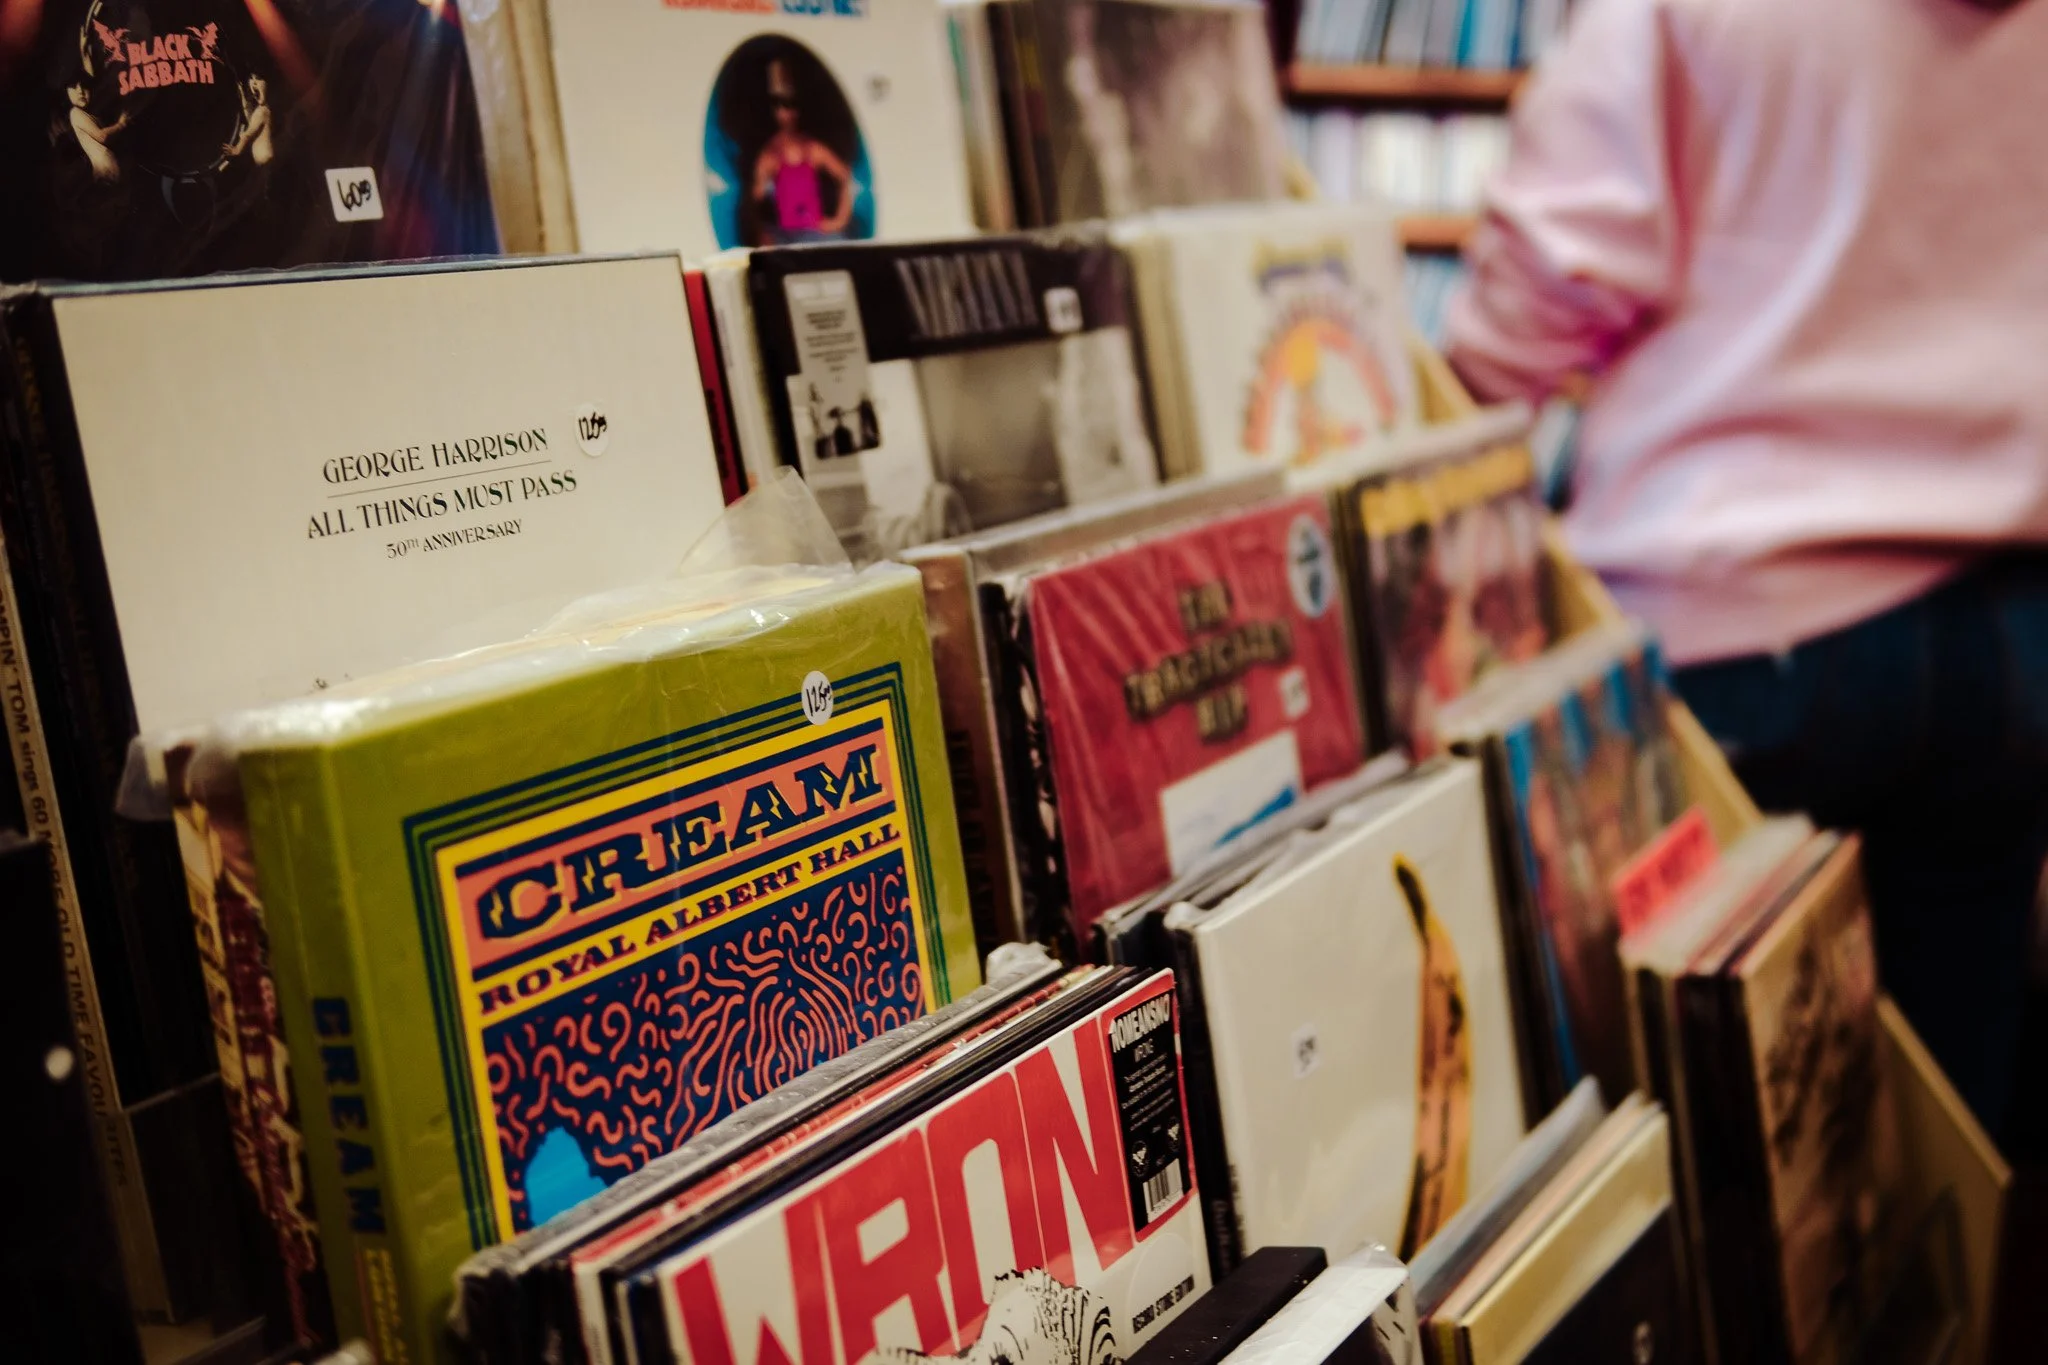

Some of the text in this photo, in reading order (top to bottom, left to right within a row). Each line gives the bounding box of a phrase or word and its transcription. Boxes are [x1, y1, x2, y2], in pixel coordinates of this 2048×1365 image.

[118, 60, 214, 96] SABBATH
[126, 33, 193, 67] BLACK
[323, 428, 549, 484] GEORGE HARRISON
[307, 469, 578, 539] ALL THINGS MUST PASS
[386, 519, 523, 560] 50TH ANNIVERSARY
[6, 683, 31, 735] TOM
[20, 739, 39, 790] sings
[32, 796, 49, 825] 60
[476, 743, 888, 941] CREAM
[480, 823, 900, 1017] ROYAL ALBERT HALL
[312, 996, 387, 1235] CREAM
